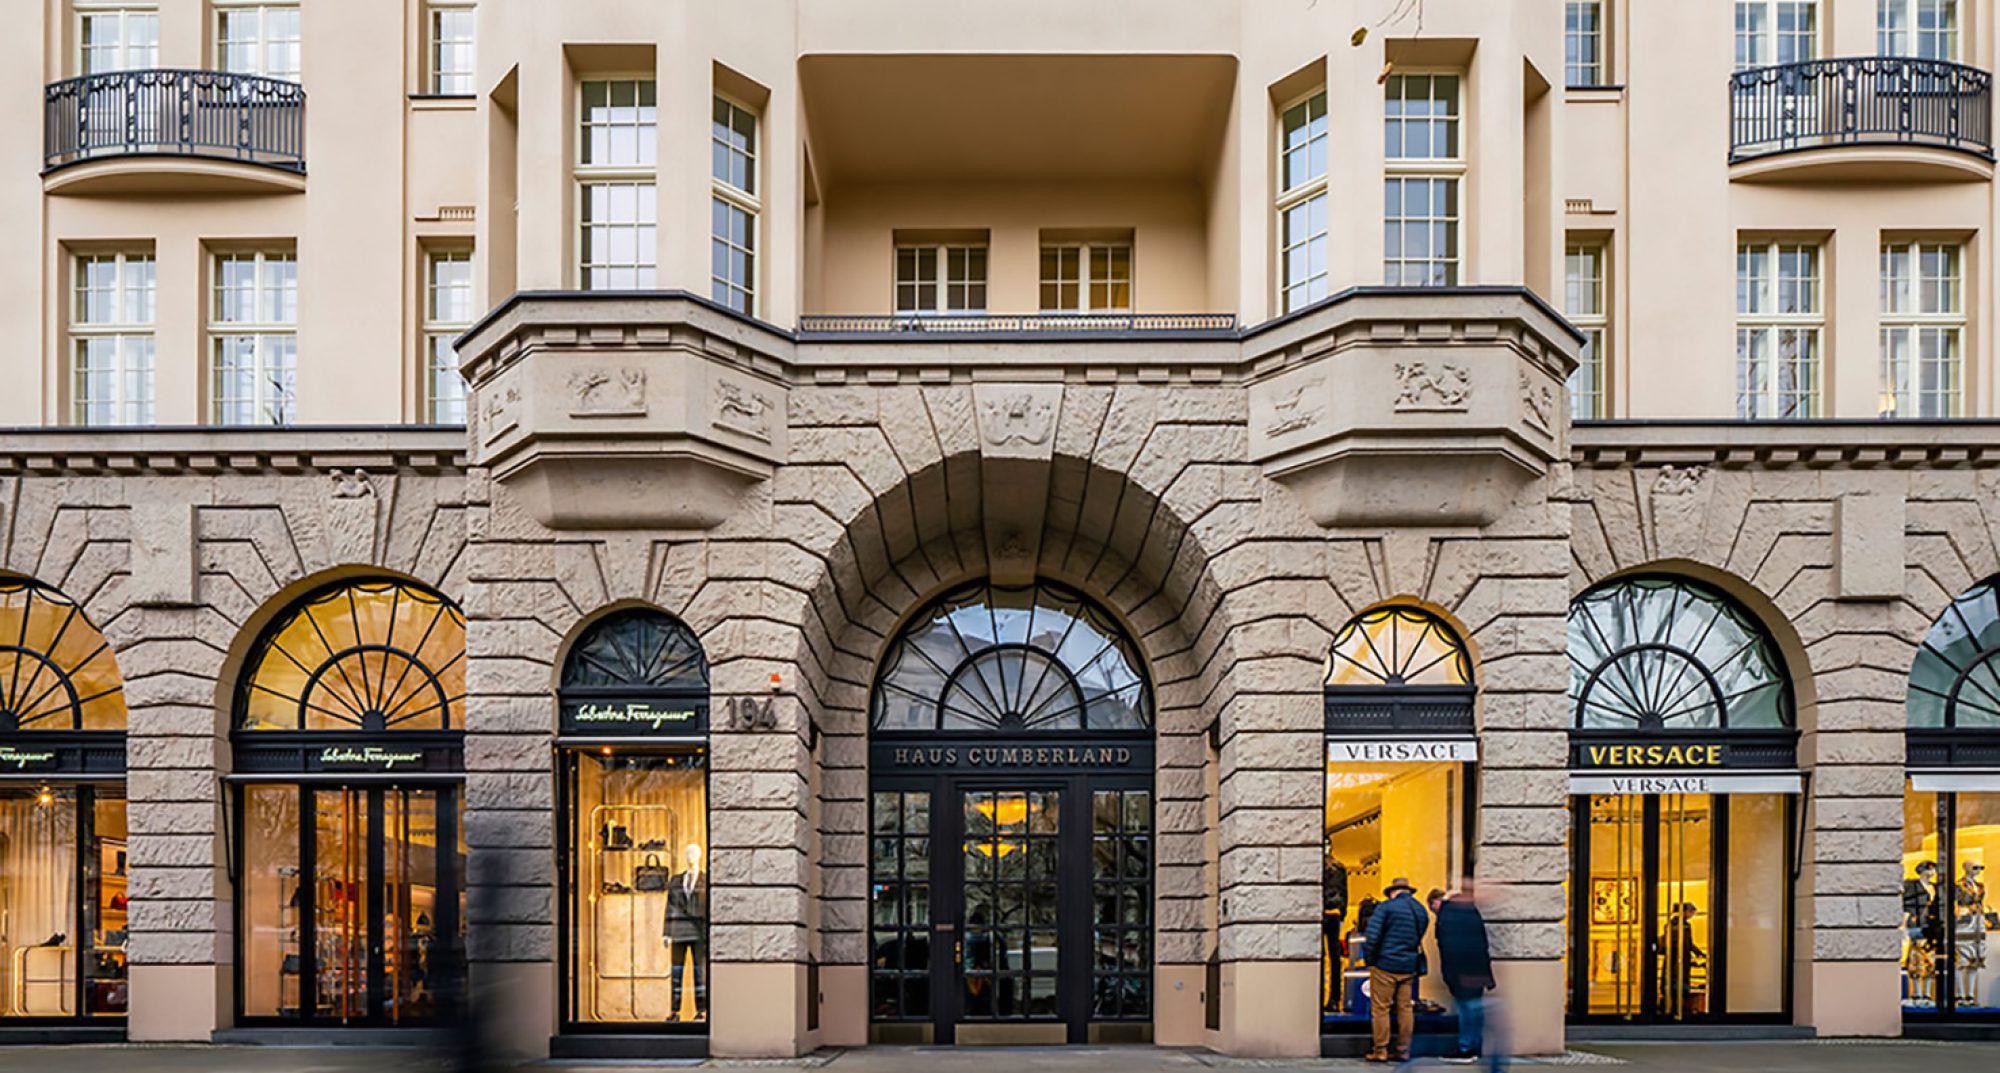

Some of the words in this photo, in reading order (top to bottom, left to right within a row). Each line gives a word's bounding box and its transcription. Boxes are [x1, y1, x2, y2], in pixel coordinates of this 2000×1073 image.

[625, 704, 695, 729] Ferragamo
[726, 695, 778, 730] 194
[362, 747, 422, 768] Ferragamo
[895, 748, 957, 764] HAUS
[968, 748, 1130, 764] CUMBERLAND
[1346, 744, 1459, 759] VERSACE
[1589, 744, 1722, 765] VERSACE
[1612, 779, 1709, 792] VERSACE
